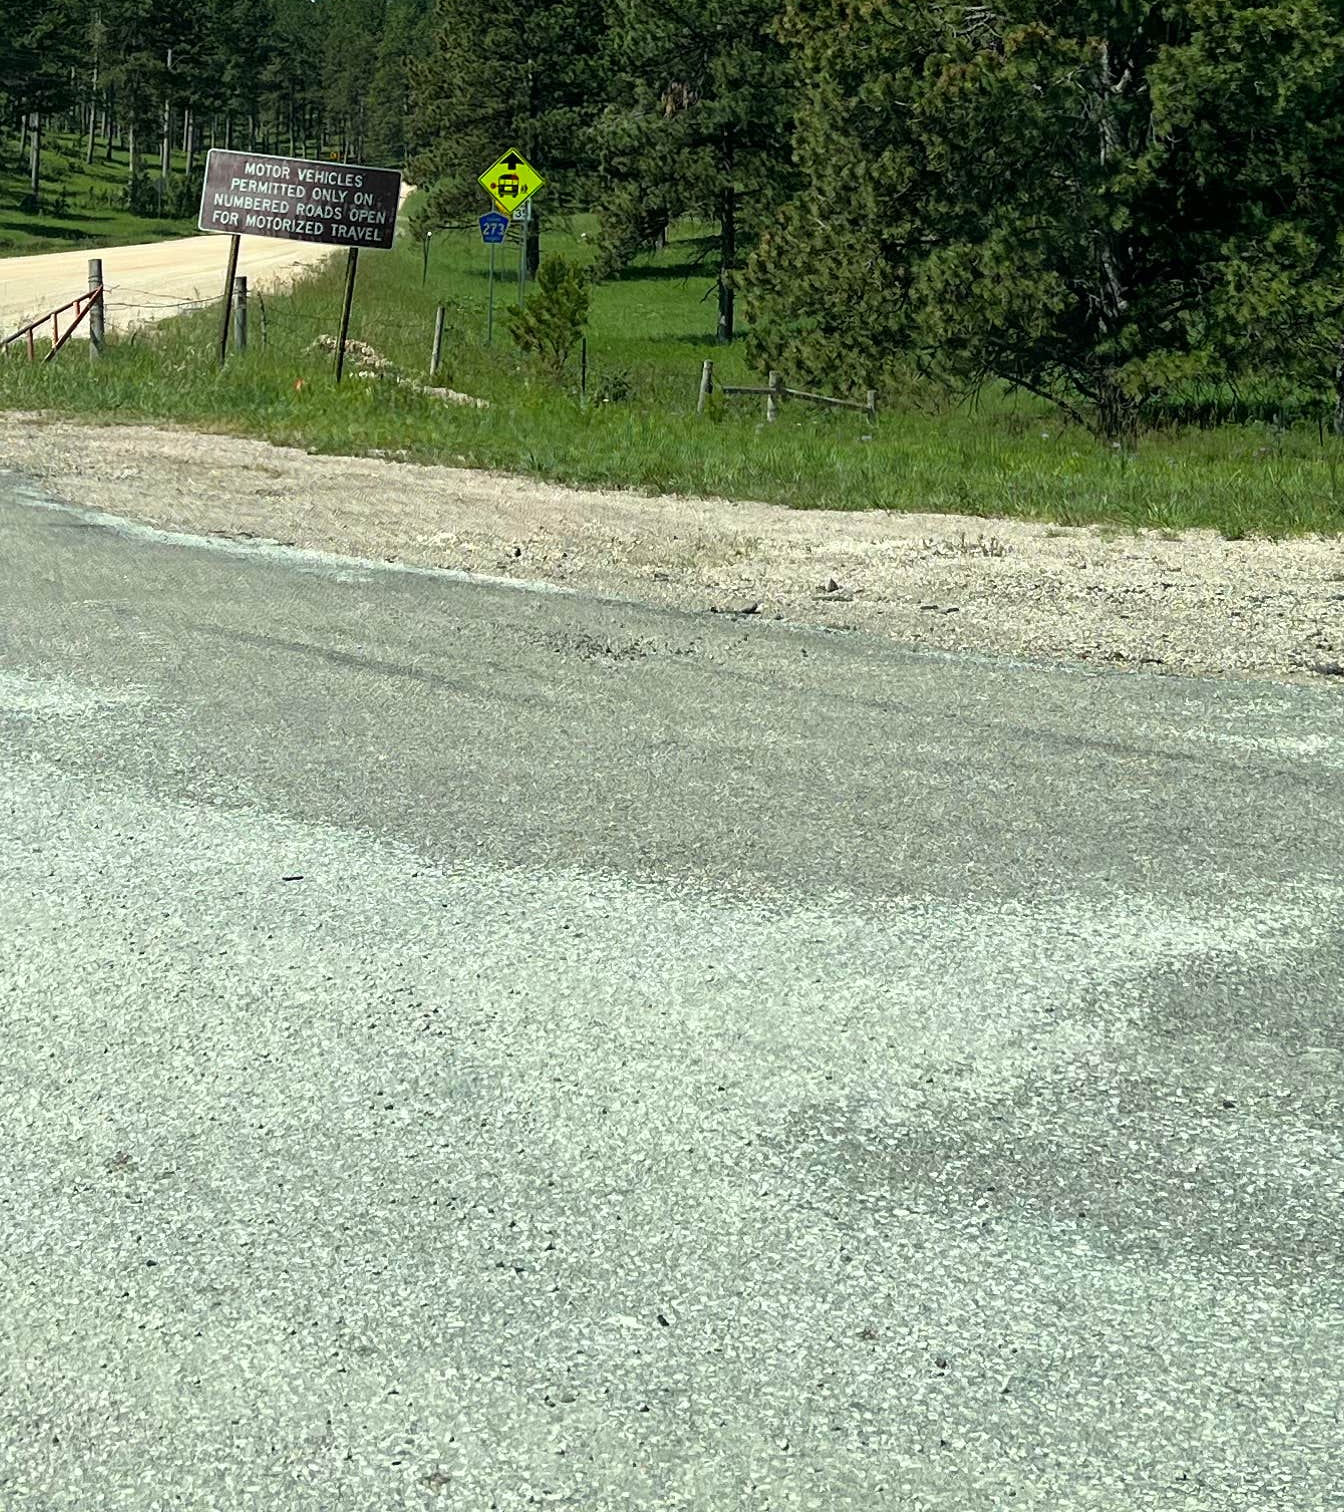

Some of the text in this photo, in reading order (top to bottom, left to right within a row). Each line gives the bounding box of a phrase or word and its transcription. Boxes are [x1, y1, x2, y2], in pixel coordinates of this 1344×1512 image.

[244, 162, 364, 188] MOTOR VEHICLES
[230, 177, 374, 206] PERMITTED ONLY ON
[213, 193, 387, 225] NUMBERED ROADS OPEN
[212, 210, 382, 241] FOR MOTORIZED TRAVEL
[483, 223, 505, 236] 273
